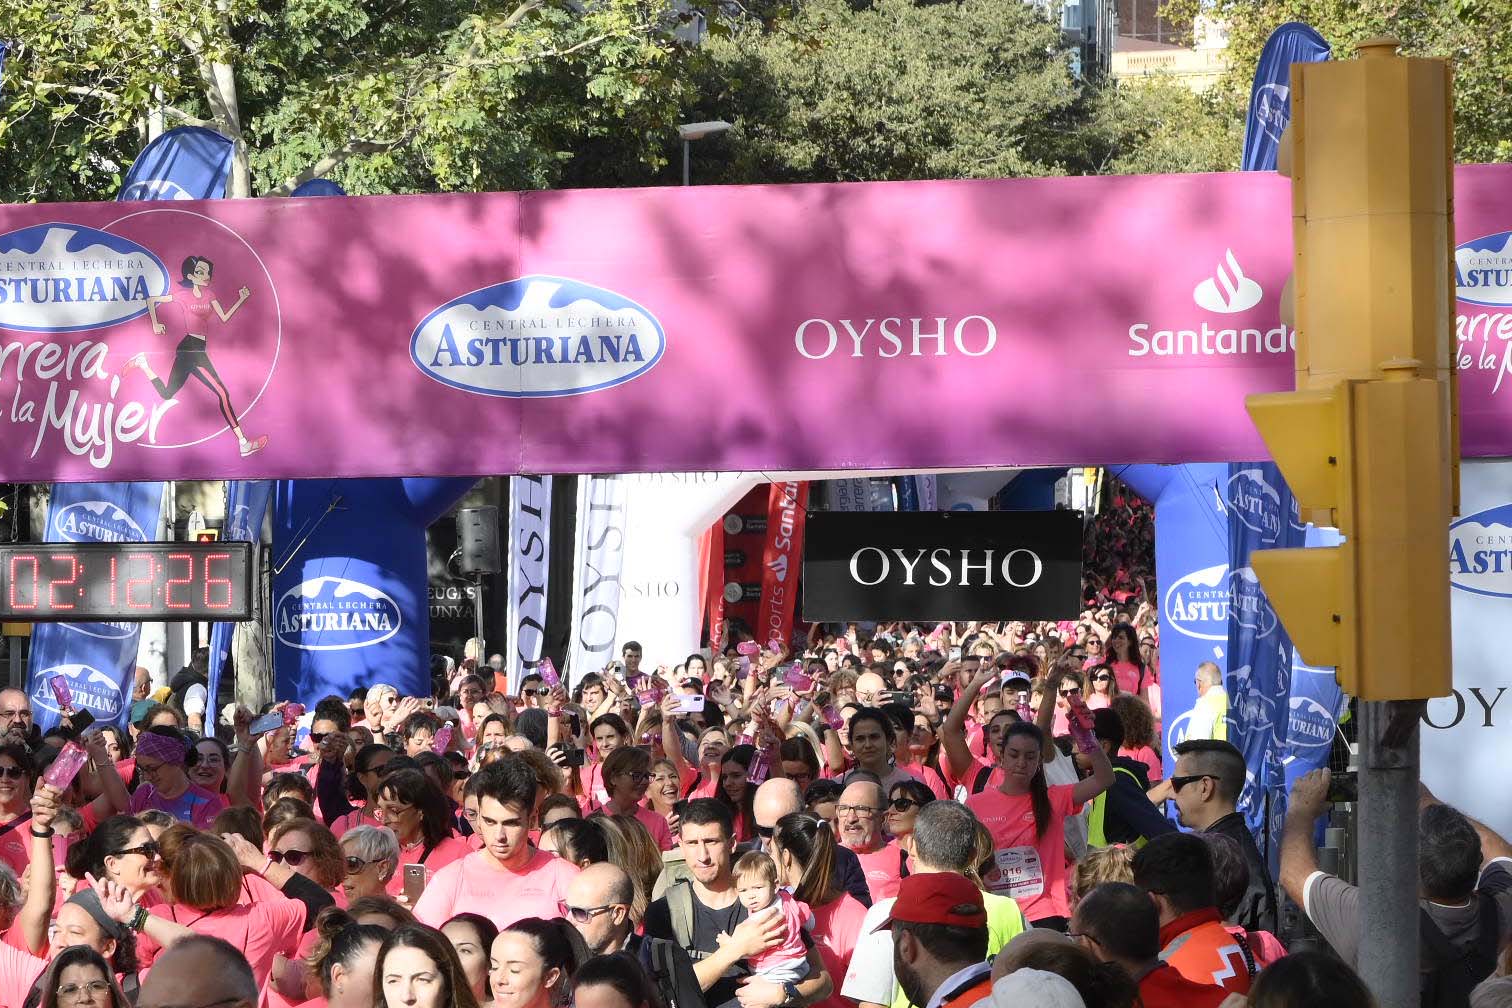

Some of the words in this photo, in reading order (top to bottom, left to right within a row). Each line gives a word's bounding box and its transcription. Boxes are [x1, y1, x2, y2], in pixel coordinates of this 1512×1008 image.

[72, 259, 145, 271] LECHERA
[468, 316, 543, 332] CENTRAL
[554, 315, 639, 330] LECHERA
[794, 314, 997, 360] OYSHO
[429, 323, 646, 368] ASTURIANA
[1478, 341, 1497, 371] la
[9, 382, 36, 424] la
[29, 374, 180, 469] Mujer
[848, 546, 1044, 588] OYSHO
[1449, 537, 1512, 575] AST
[9, 553, 233, 609] 02:12:26
[279, 605, 393, 635] ASTURIANA
[291, 602, 334, 611] CENTRAL
[1171, 591, 1230, 622] ASTU
[1002, 866, 1022, 876] 016
